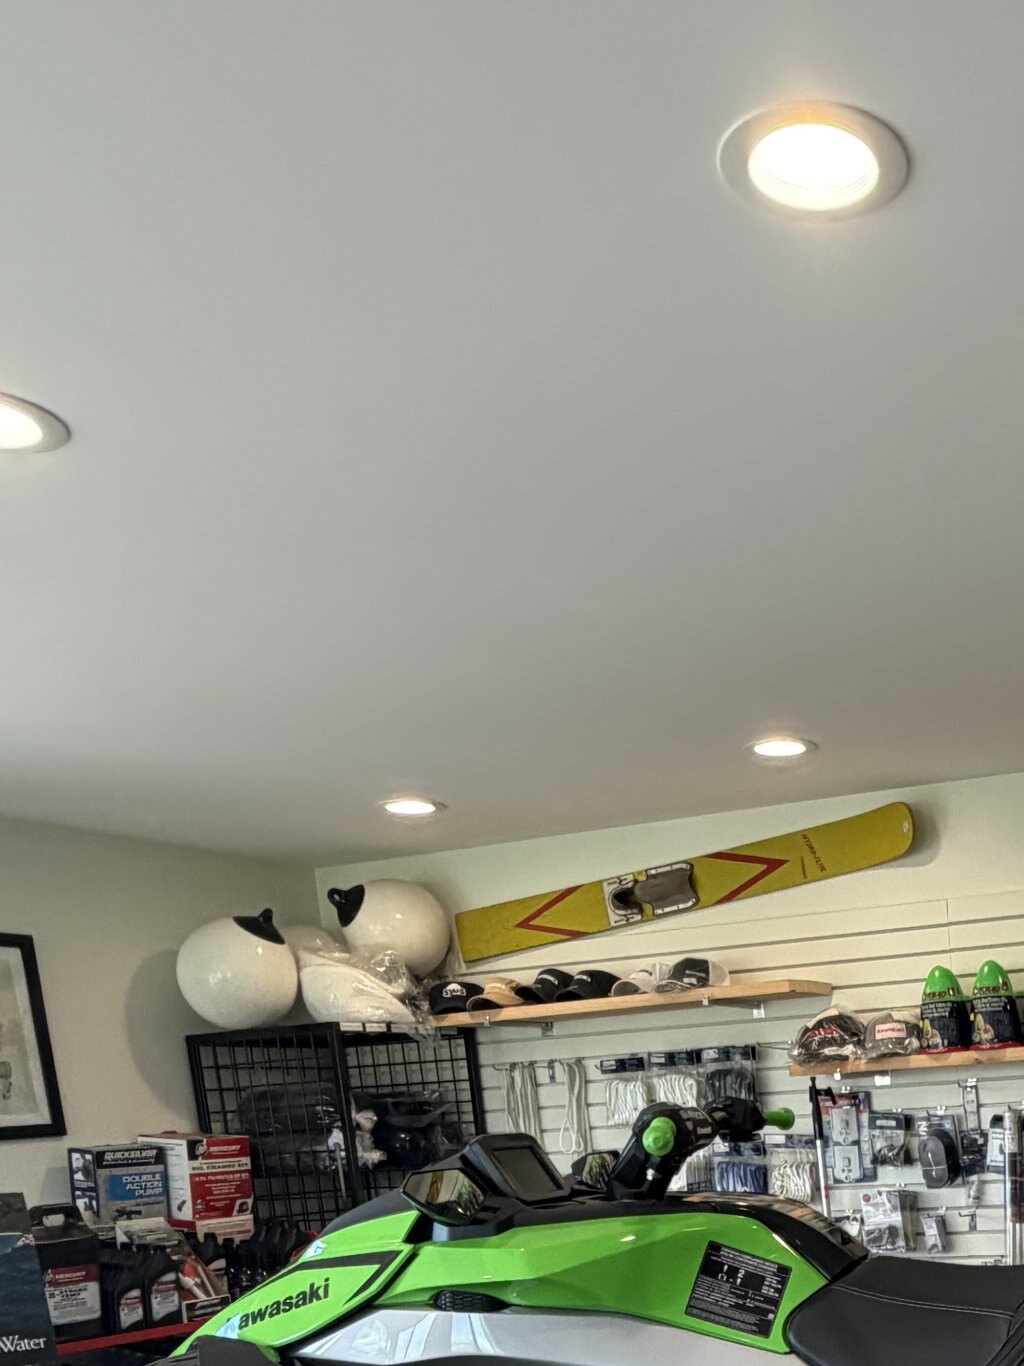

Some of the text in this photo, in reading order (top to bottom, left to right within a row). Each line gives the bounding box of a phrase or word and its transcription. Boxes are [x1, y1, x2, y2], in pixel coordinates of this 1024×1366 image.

[122, 1173, 162, 1183] DOUBLE
[124, 1182, 163, 1190] ACTION
[134, 1188, 163, 1197] PUMP
[225, 1277, 330, 1331] awasaki
